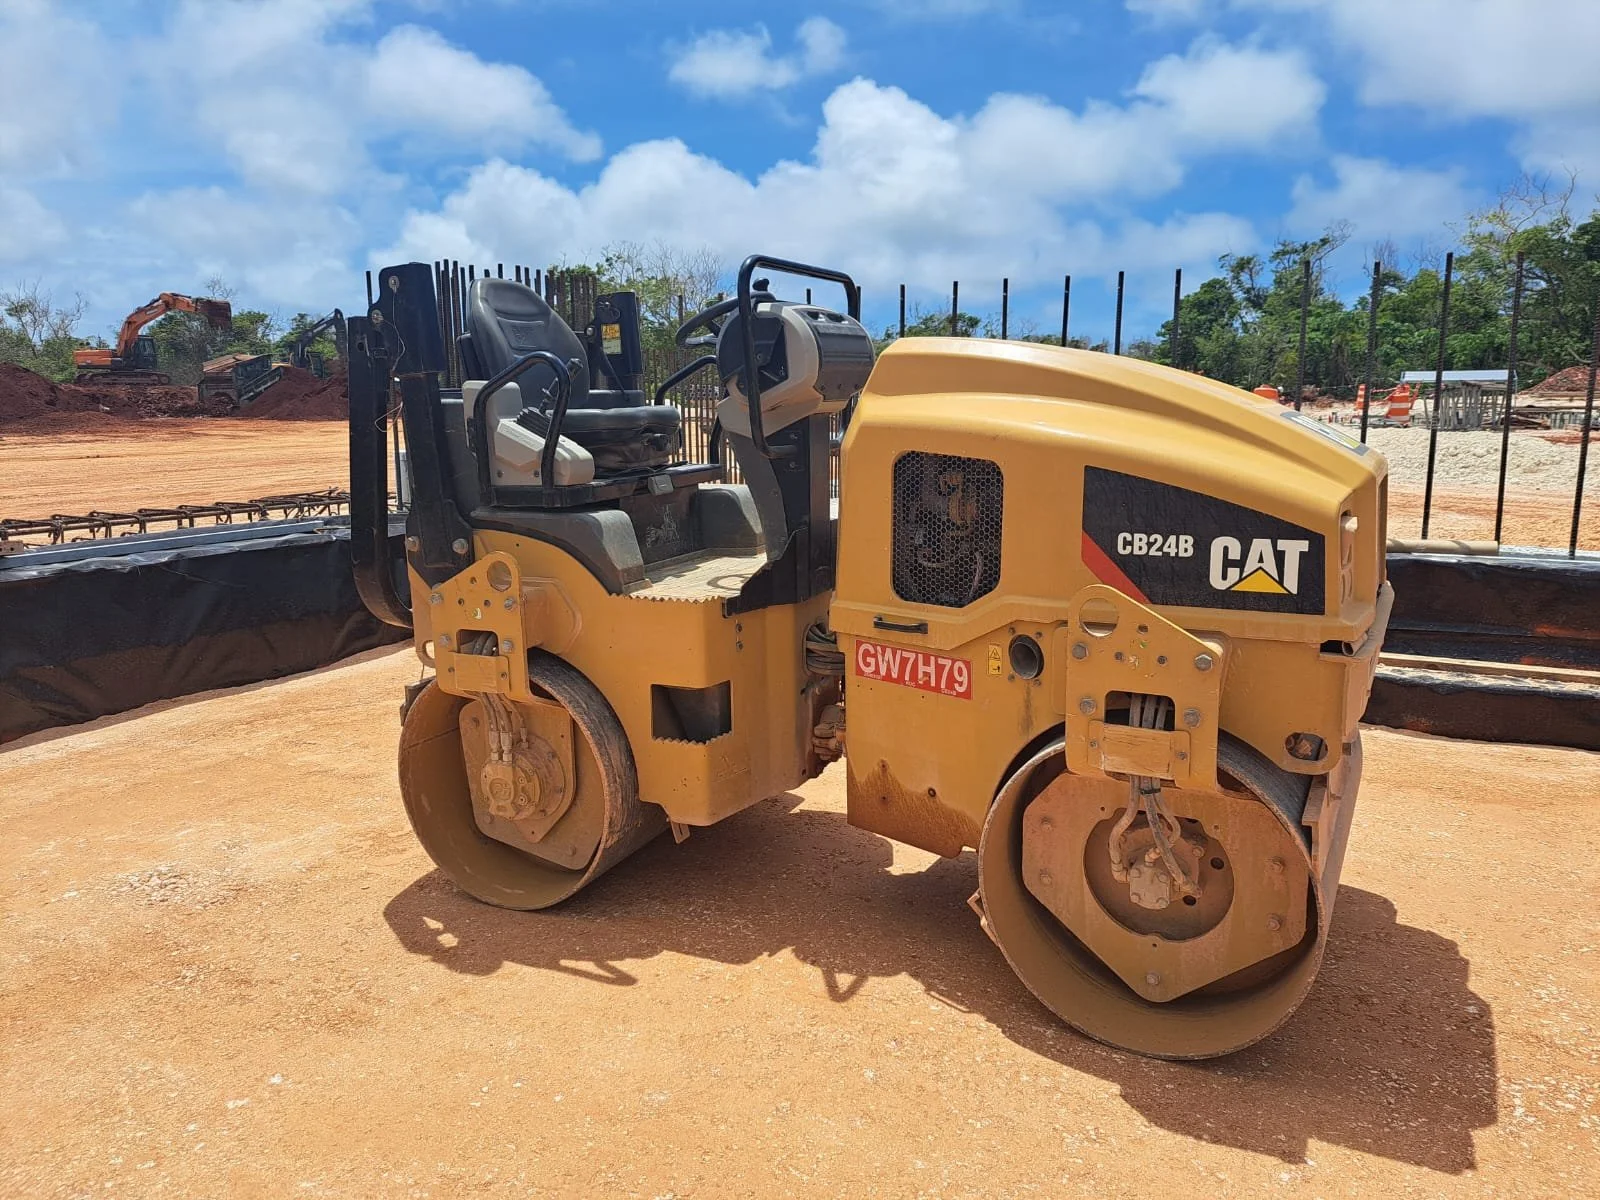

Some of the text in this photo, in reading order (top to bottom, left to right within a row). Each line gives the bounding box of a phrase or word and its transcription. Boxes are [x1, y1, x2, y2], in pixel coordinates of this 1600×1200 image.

[1117, 532, 1309, 595] CB24B CAT
[858, 643, 968, 693] GW7H79
